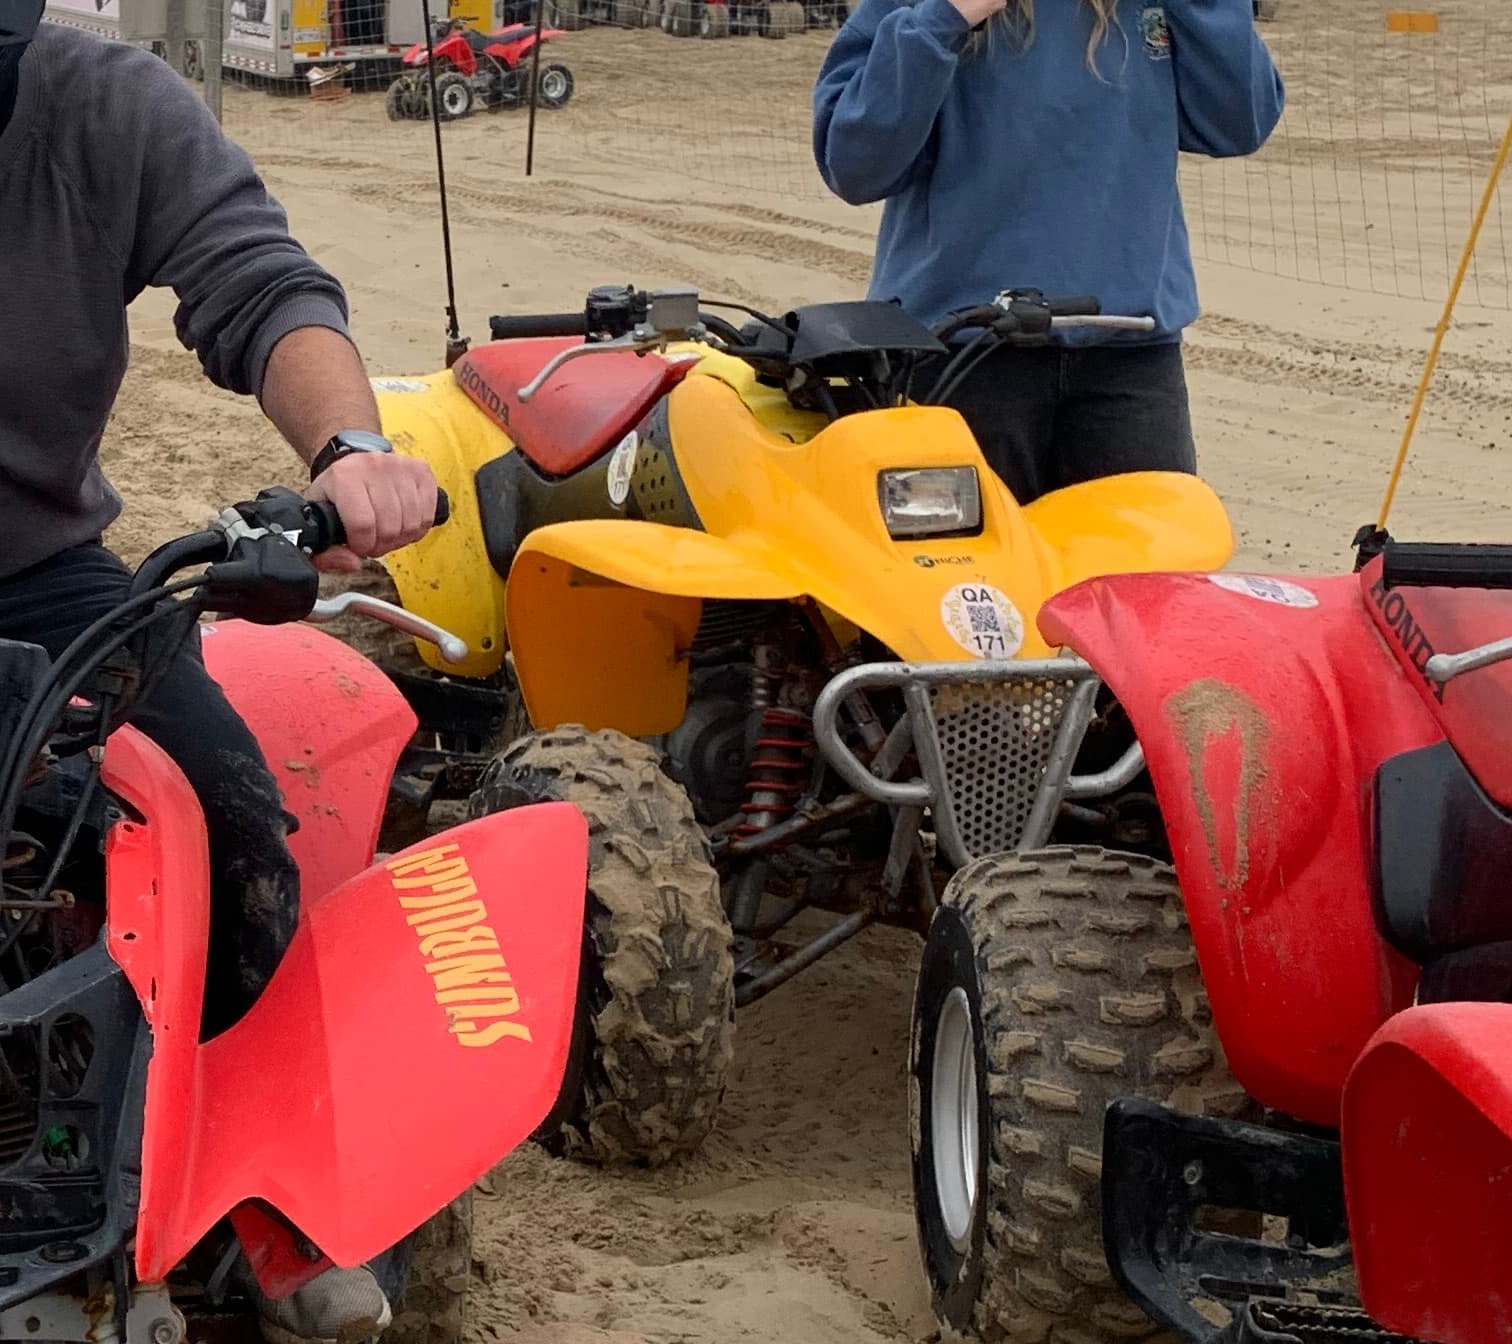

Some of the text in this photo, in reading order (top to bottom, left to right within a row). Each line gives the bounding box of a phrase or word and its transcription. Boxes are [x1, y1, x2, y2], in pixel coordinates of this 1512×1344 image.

[460, 360, 510, 428] HONDA
[962, 587, 994, 603] QA
[972, 635, 1006, 651] 171
[385, 842, 534, 1048] SUNBUGGY
